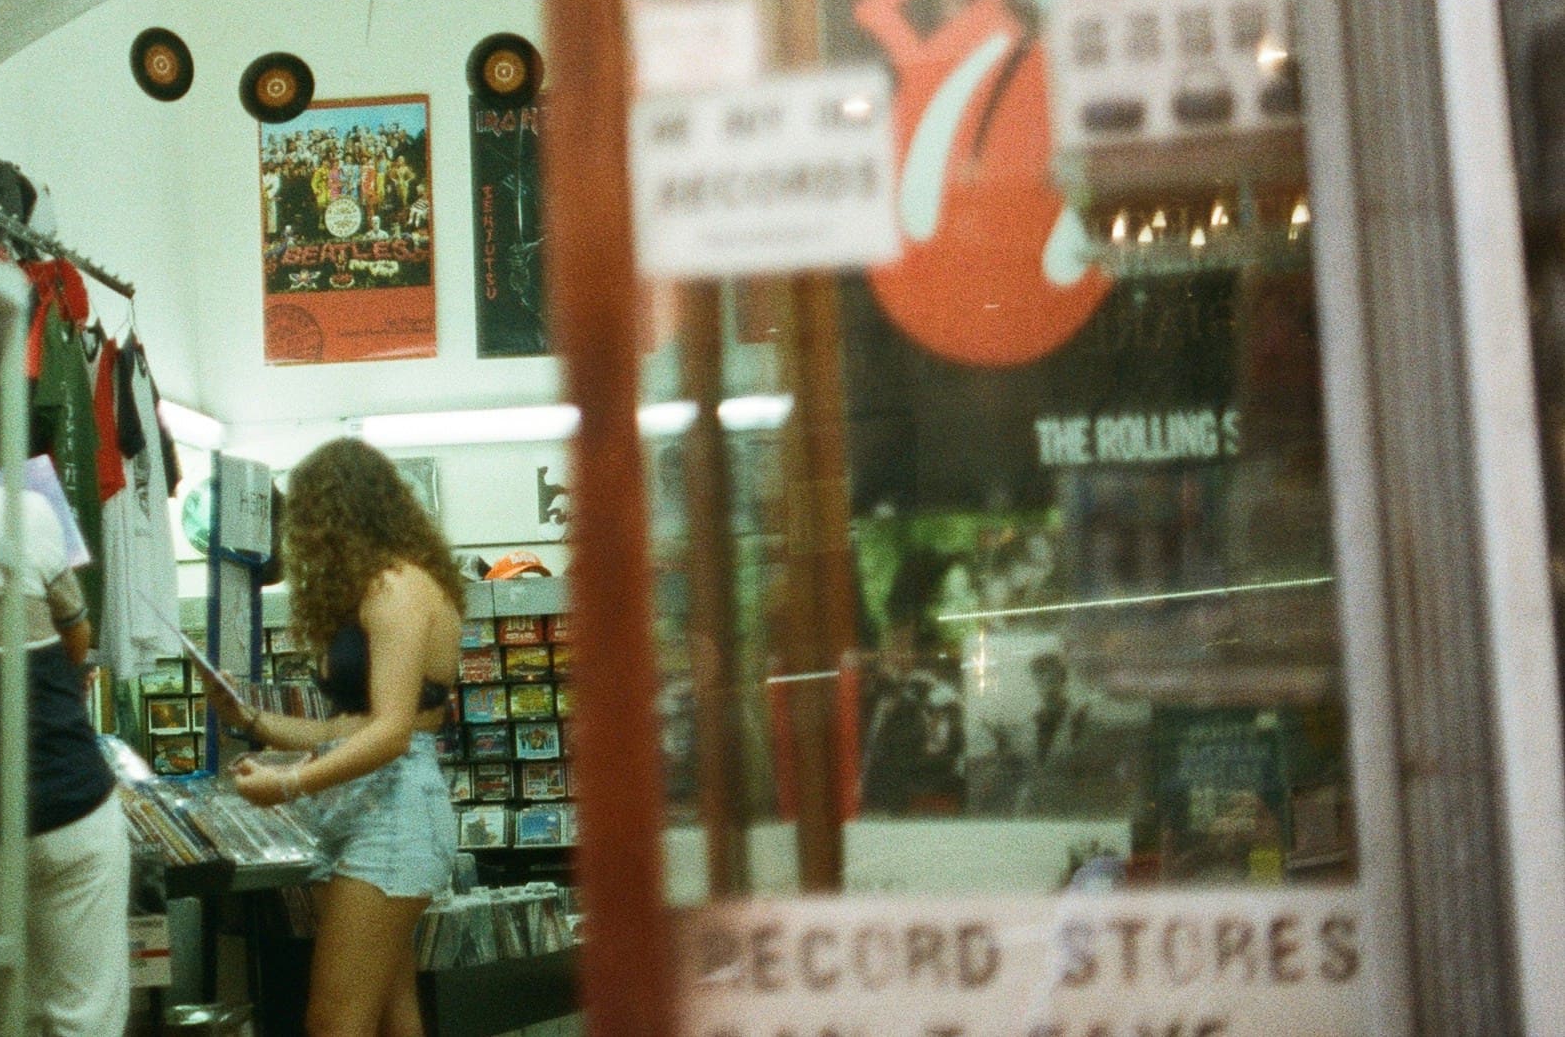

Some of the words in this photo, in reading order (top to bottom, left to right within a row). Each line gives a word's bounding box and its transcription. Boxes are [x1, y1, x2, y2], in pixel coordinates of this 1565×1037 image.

[1034, 415, 1091, 464] THE
[1093, 410, 1219, 462] ROLLING
[1058, 913, 1362, 988] STORES
